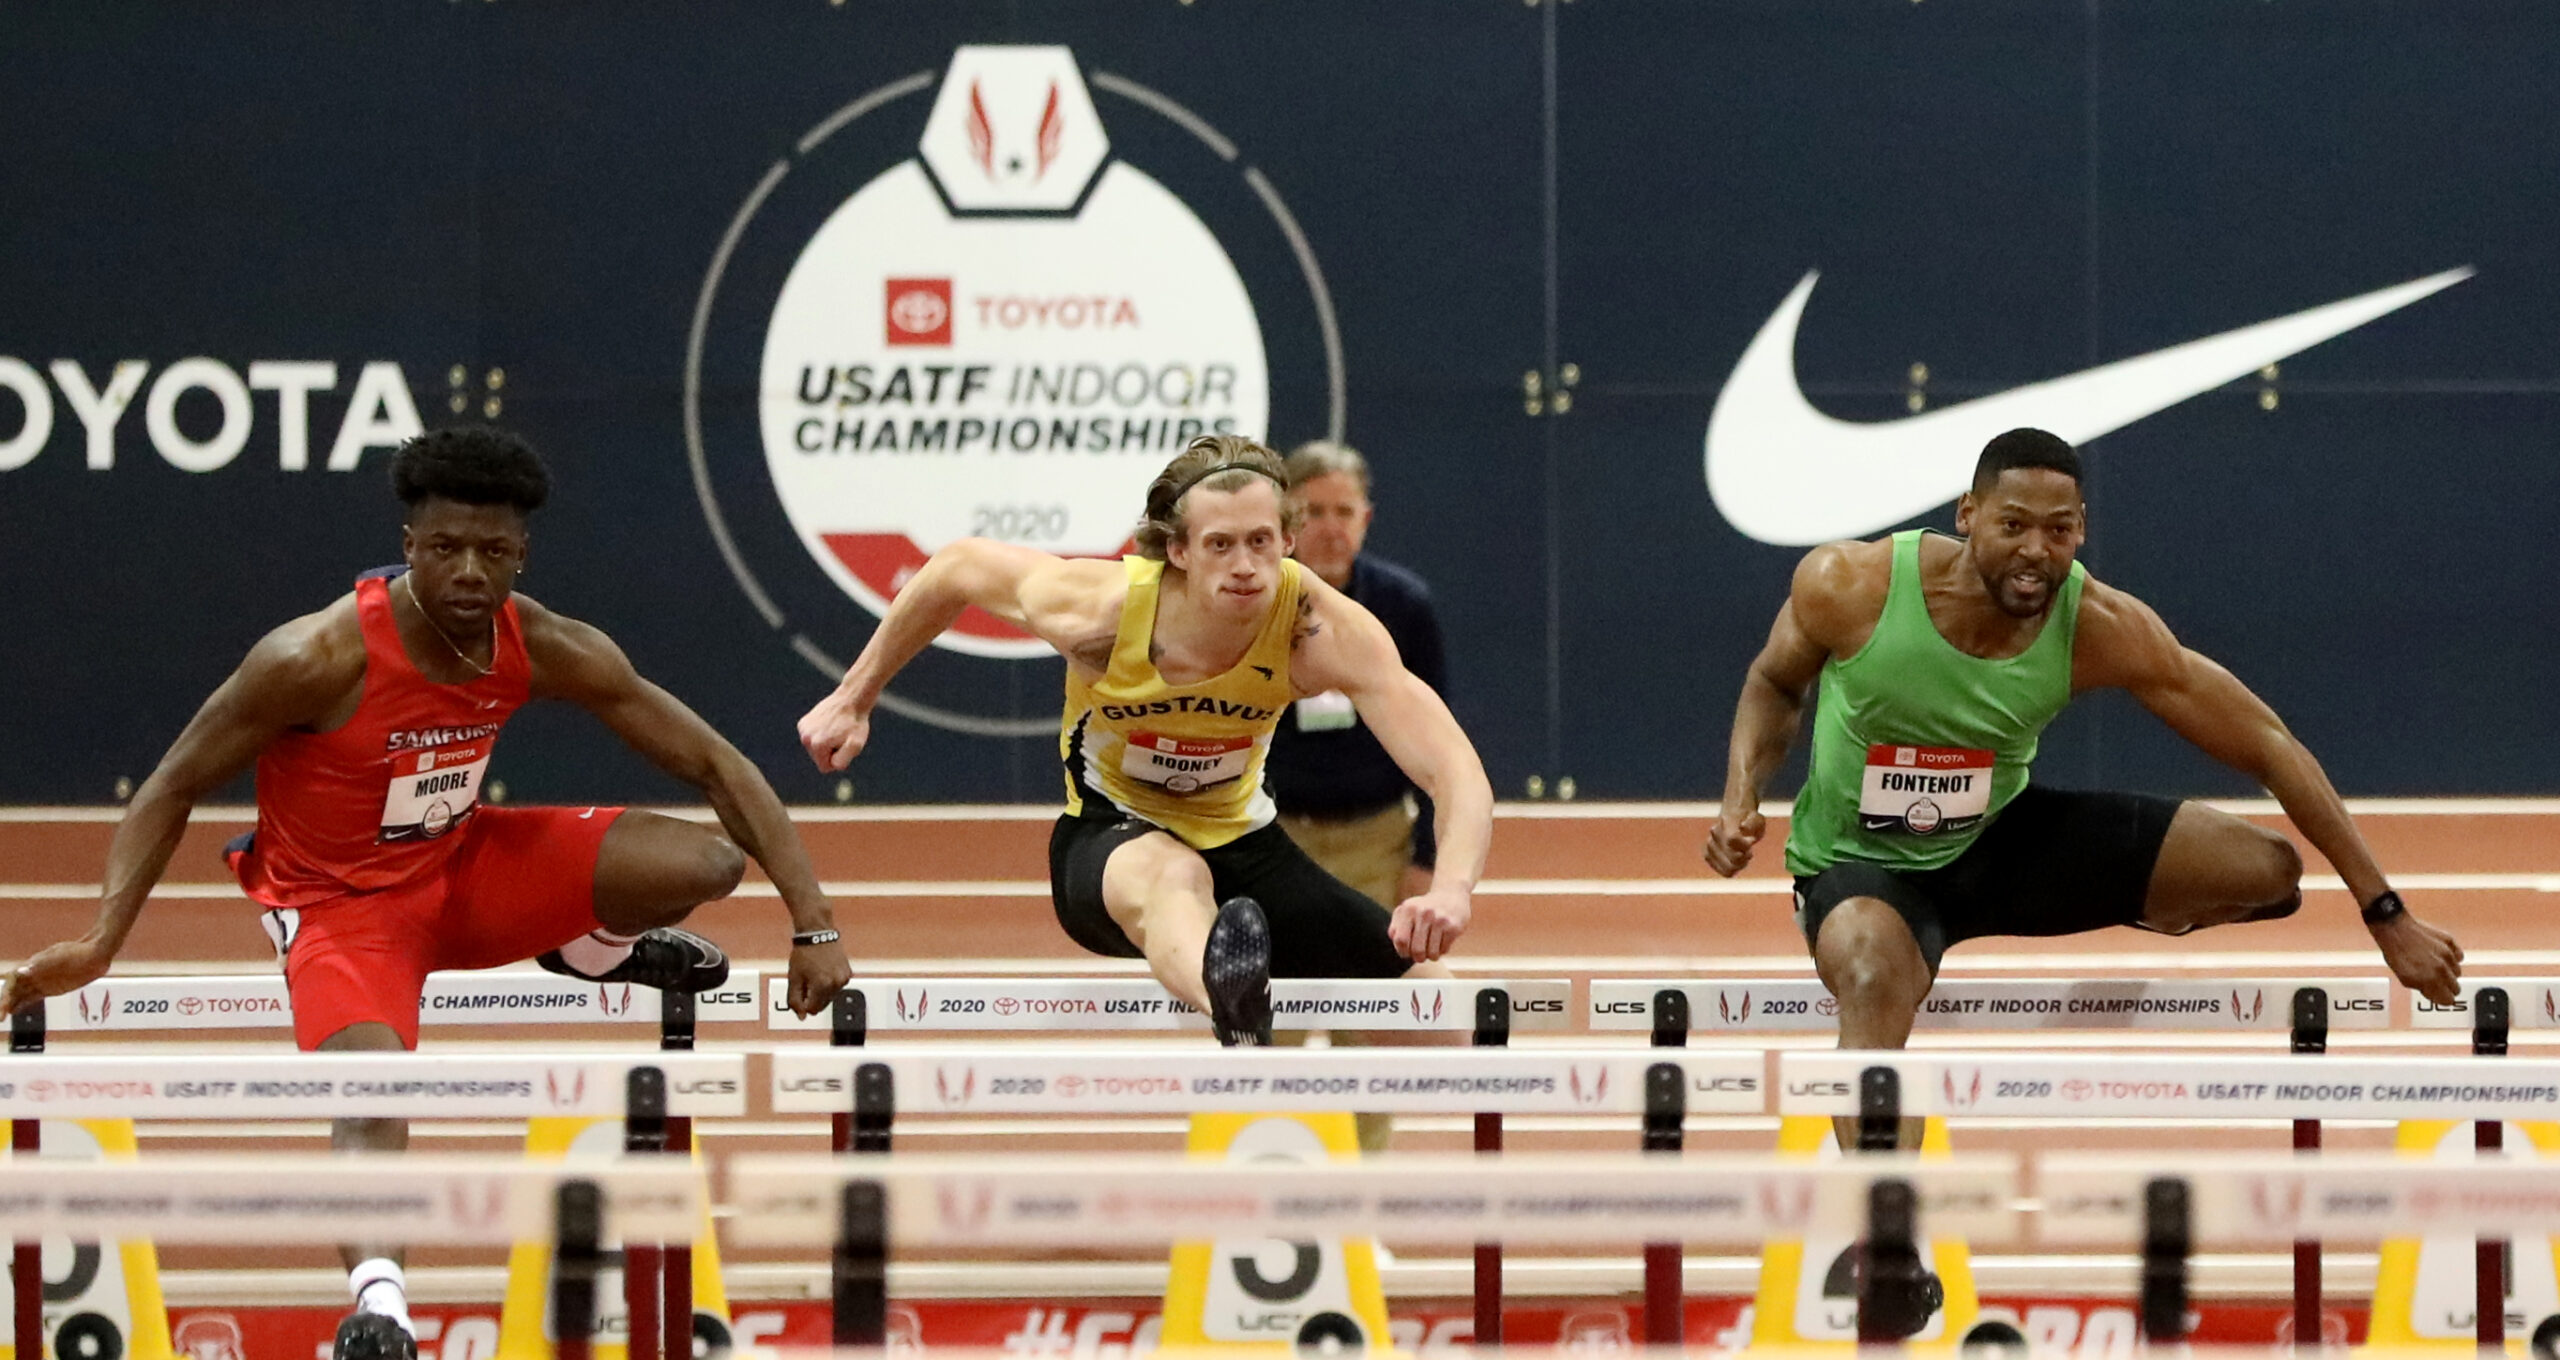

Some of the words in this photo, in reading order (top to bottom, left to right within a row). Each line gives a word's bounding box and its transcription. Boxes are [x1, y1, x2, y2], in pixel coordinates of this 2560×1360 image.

[976, 299, 1139, 330] TOYOTA
[797, 364, 991, 407] USATF
[1006, 364, 1236, 407] INDOOR
[0, 356, 424, 472] OYOTA
[795, 417, 1236, 453] CHAMPIONSHIPS
[972, 506, 1068, 540] 2020
[438, 749, 476, 762] TOYOTA
[1152, 754, 1223, 773] ROONEY
[1920, 753, 1966, 763] TOYOTA
[414, 770, 470, 798] MOORE
[1881, 773, 1974, 794] FONTENOT
[123, 1000, 169, 1014] 2020
[208, 998, 281, 1013] TOYOTA
[433, 994, 588, 1009] CHAMPIONSHIPS
[701, 992, 752, 1004] UCS
[940, 999, 985, 1013] 2020
[1024, 999, 1098, 1013] TOYOTA
[1104, 1000, 1163, 1013] USATF
[1273, 1000, 1400, 1013] AMPIONSHIPS
[1513, 1000, 1564, 1012] UCS
[1762, 1001, 1808, 1014] 2020
[1926, 999, 1984, 1013] USATF
[1989, 999, 2062, 1013] INDOOR
[2068, 999, 2220, 1013] CHAMPIONSHIPS
[2334, 999, 2385, 1011] UCS
[1595, 1002, 1645, 1013] UCS
[63, 1081, 153, 1099] TOYOTA
[164, 1081, 236, 1098] USATF
[242, 1081, 333, 1098] INDOOR
[342, 1080, 532, 1098] CHAMPIONSHIPS
[675, 1080, 737, 1094] UCS
[780, 1079, 843, 1092] UCS
[990, 1078, 1046, 1095] 2020
[1093, 1078, 1183, 1095] TOYOTA
[1191, 1078, 1264, 1094] USATF
[1270, 1078, 1360, 1094] INDOOR
[1367, 1077, 1556, 1094] CHAMPIONSHIPS
[1695, 1078, 1757, 1092] UCS
[1789, 1082, 1850, 1096] UCS
[1996, 1080, 2052, 1097] 2020
[2098, 1081, 2188, 1098] TOYOTA
[2196, 1083, 2268, 1100] USATF
[2274, 1083, 2363, 1101] INDOOR
[2371, 1083, 2559, 1102] CHAMPIONSHIPS
[1236, 1313, 1299, 1331] UC
